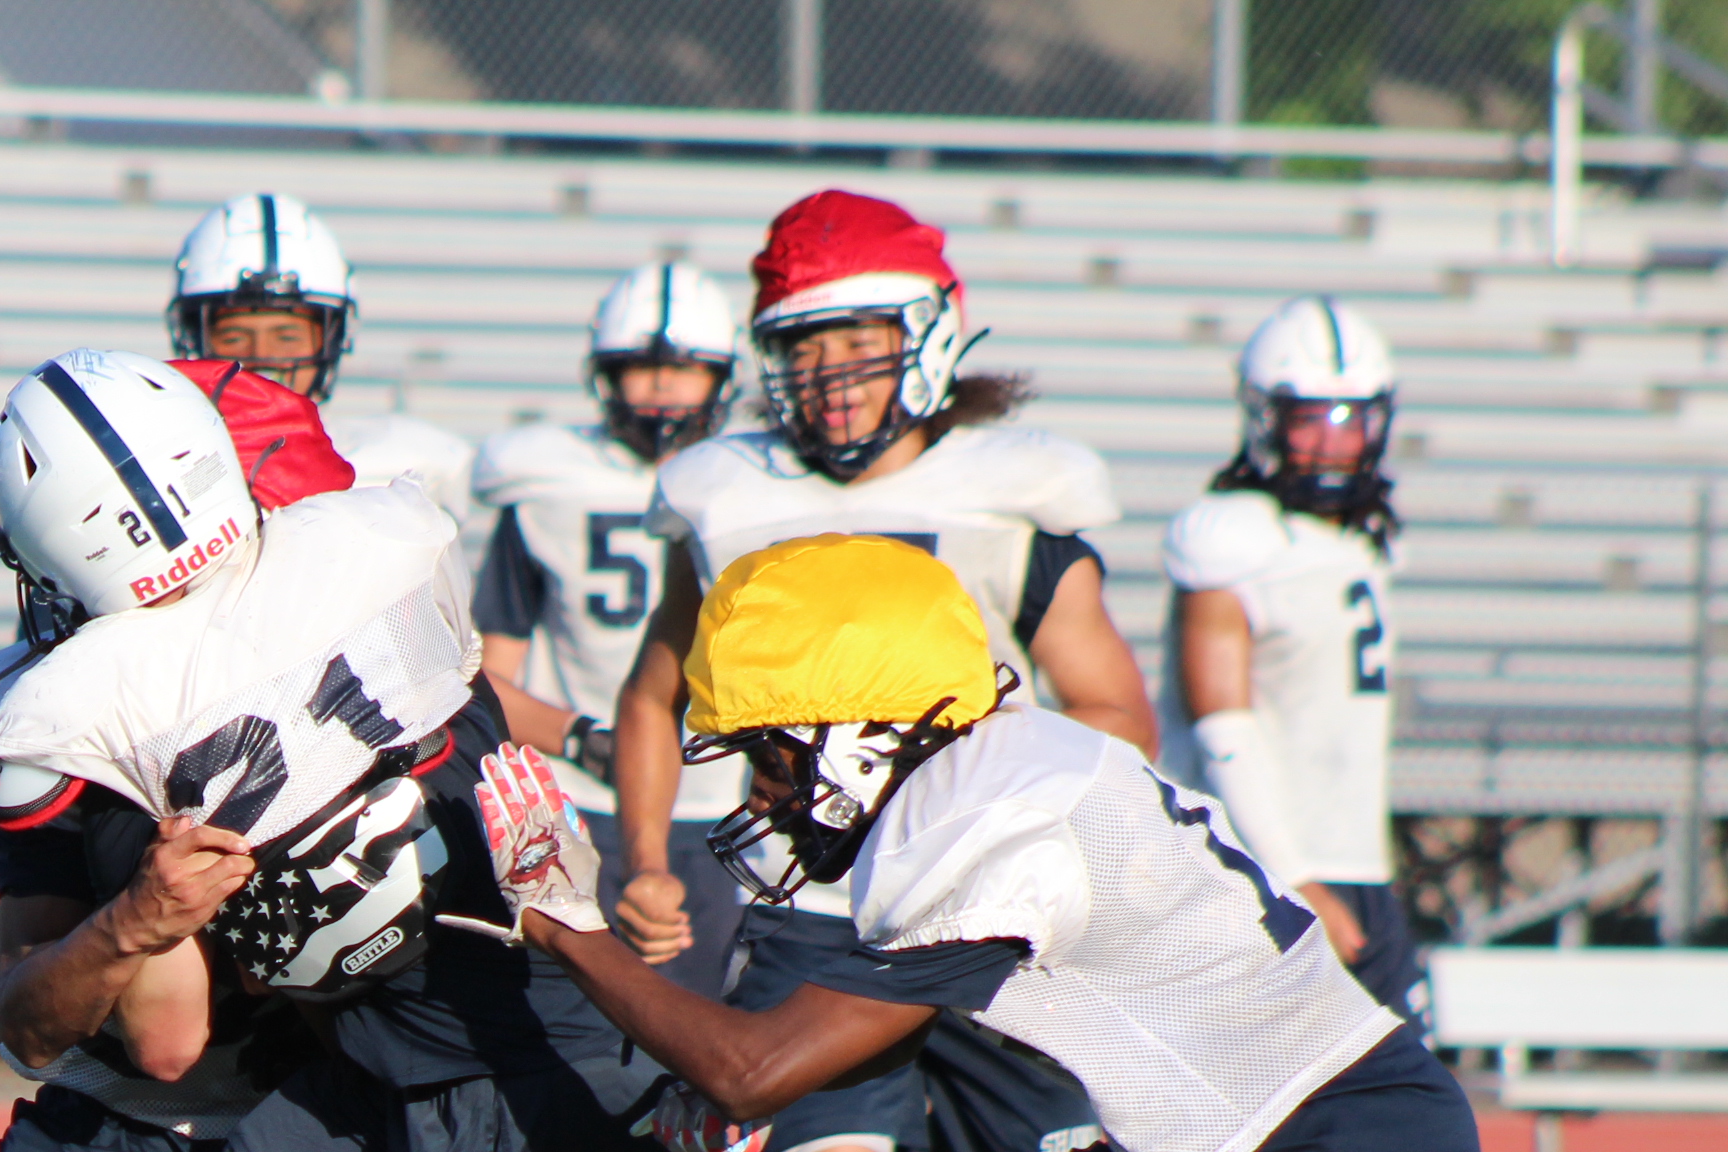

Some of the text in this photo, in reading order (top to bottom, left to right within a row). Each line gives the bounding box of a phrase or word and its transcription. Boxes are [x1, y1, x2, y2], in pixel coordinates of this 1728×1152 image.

[118, 483, 191, 548] 2 1
[129, 517, 242, 602] Riddell
[586, 511, 650, 629] 5
[1344, 578, 1387, 694] 2
[345, 930, 399, 971] BATTLE
